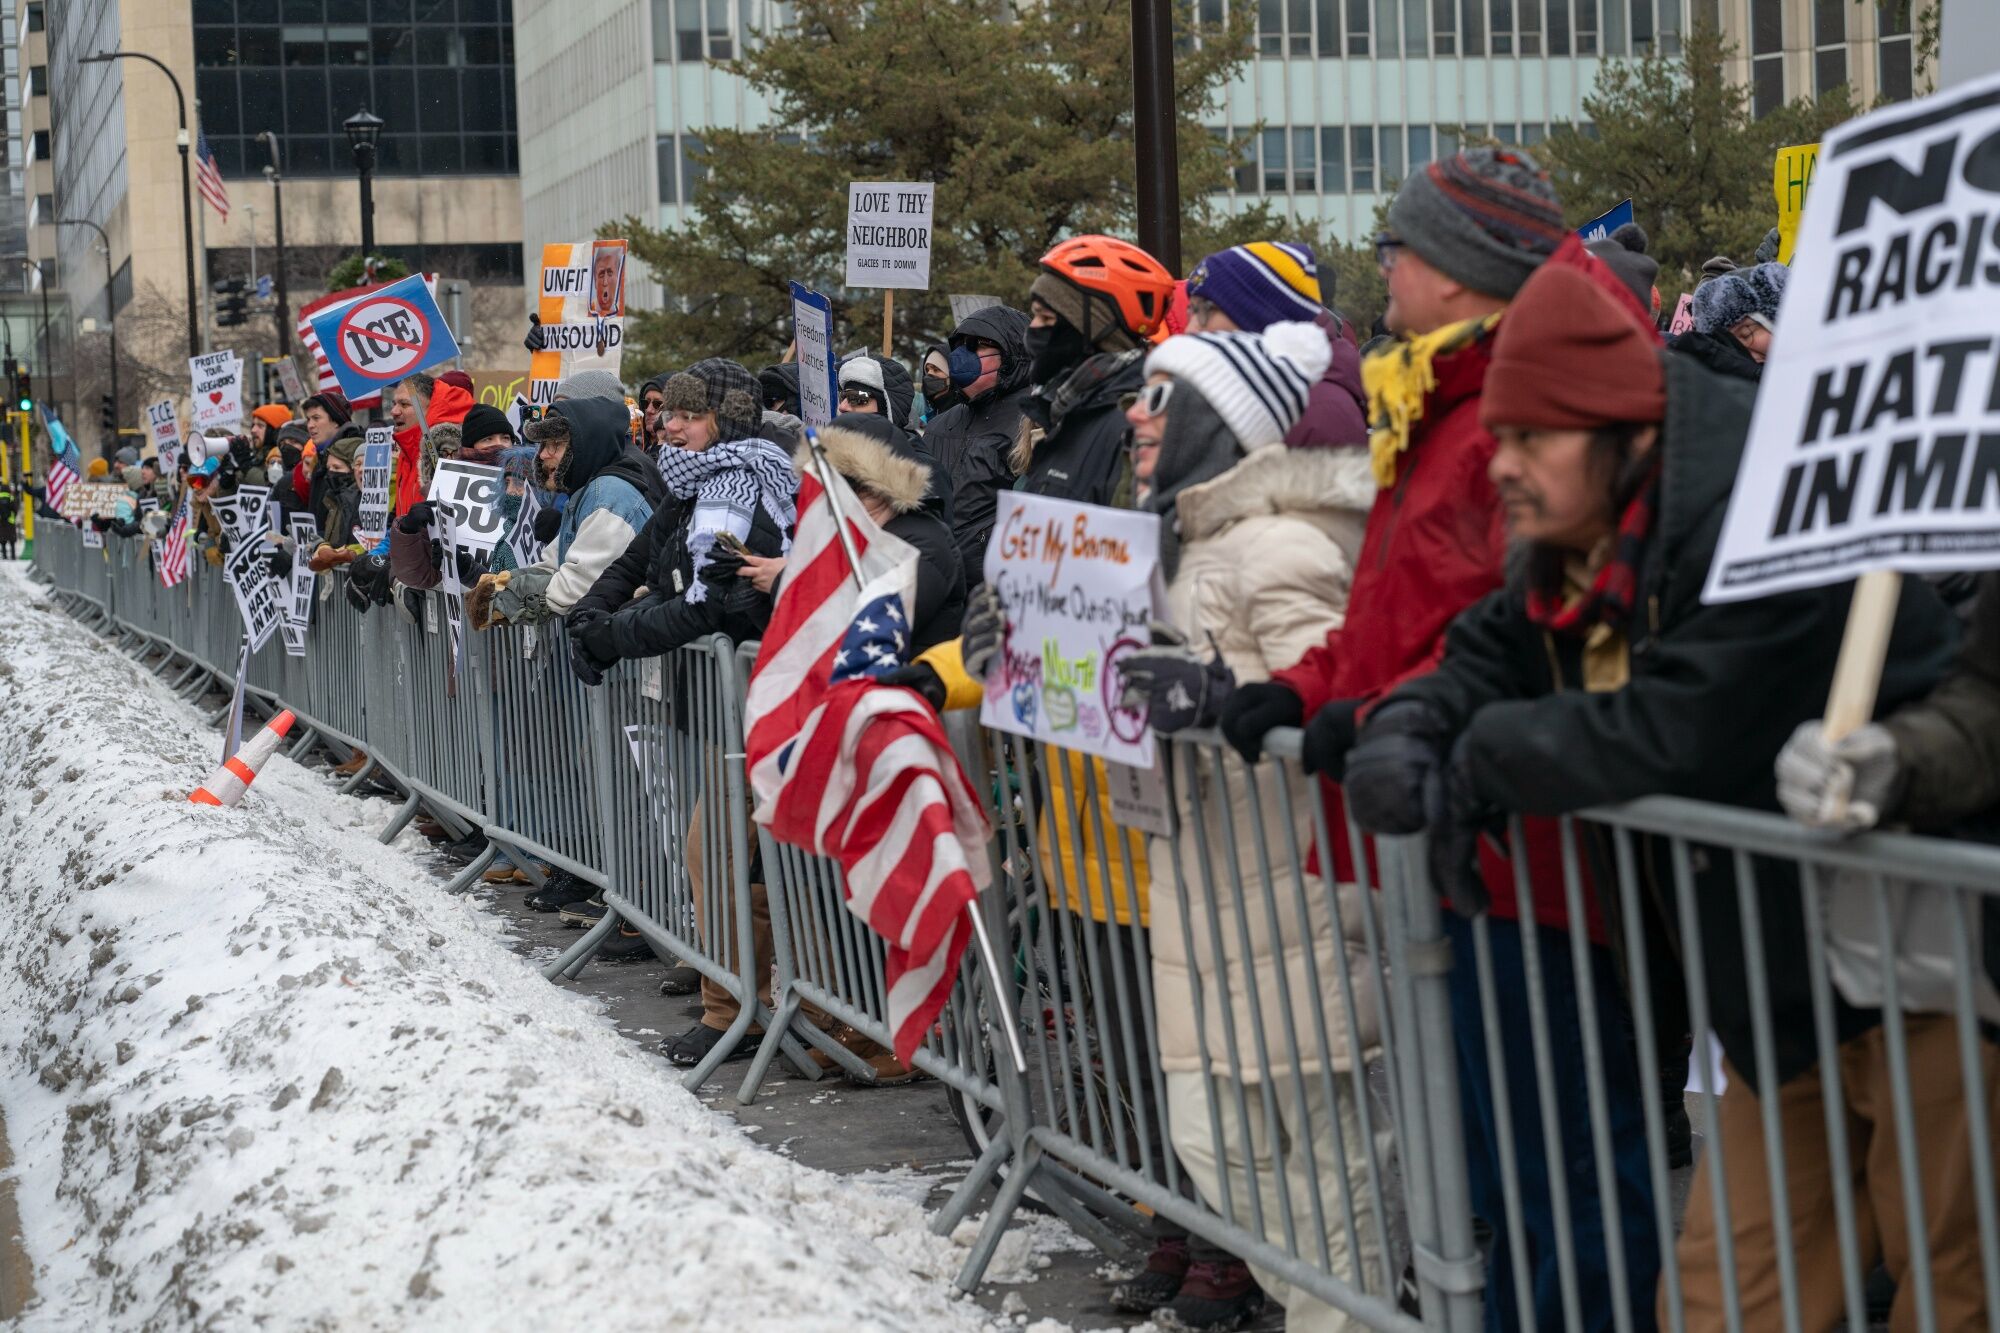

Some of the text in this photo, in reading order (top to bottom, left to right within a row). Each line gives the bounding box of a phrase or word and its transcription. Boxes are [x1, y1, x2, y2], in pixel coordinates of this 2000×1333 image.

[854, 192, 928, 214] LOVE THY
[852, 225, 928, 249] NEIGHBOR
[857, 258, 917, 269] GLACIES ITE DOMVM
[544, 268, 588, 293] UNFIT
[346, 308, 421, 367] ICE
[541, 324, 621, 350] UNSOUND
[796, 318, 826, 346] Freedom
[194, 352, 229, 369] PROTECT
[204, 365, 225, 377] YOUR
[801, 346, 824, 373] Justice
[471, 377, 525, 412] OVE
[530, 380, 558, 404] UN
[802, 383, 827, 413] Liberty
[149, 400, 175, 426] ICE
[240, 496, 261, 513] NO
[1769, 448, 1867, 540] IN
[232, 540, 266, 584] NO
[248, 583, 269, 619] HAT
[263, 601, 277, 625] M
